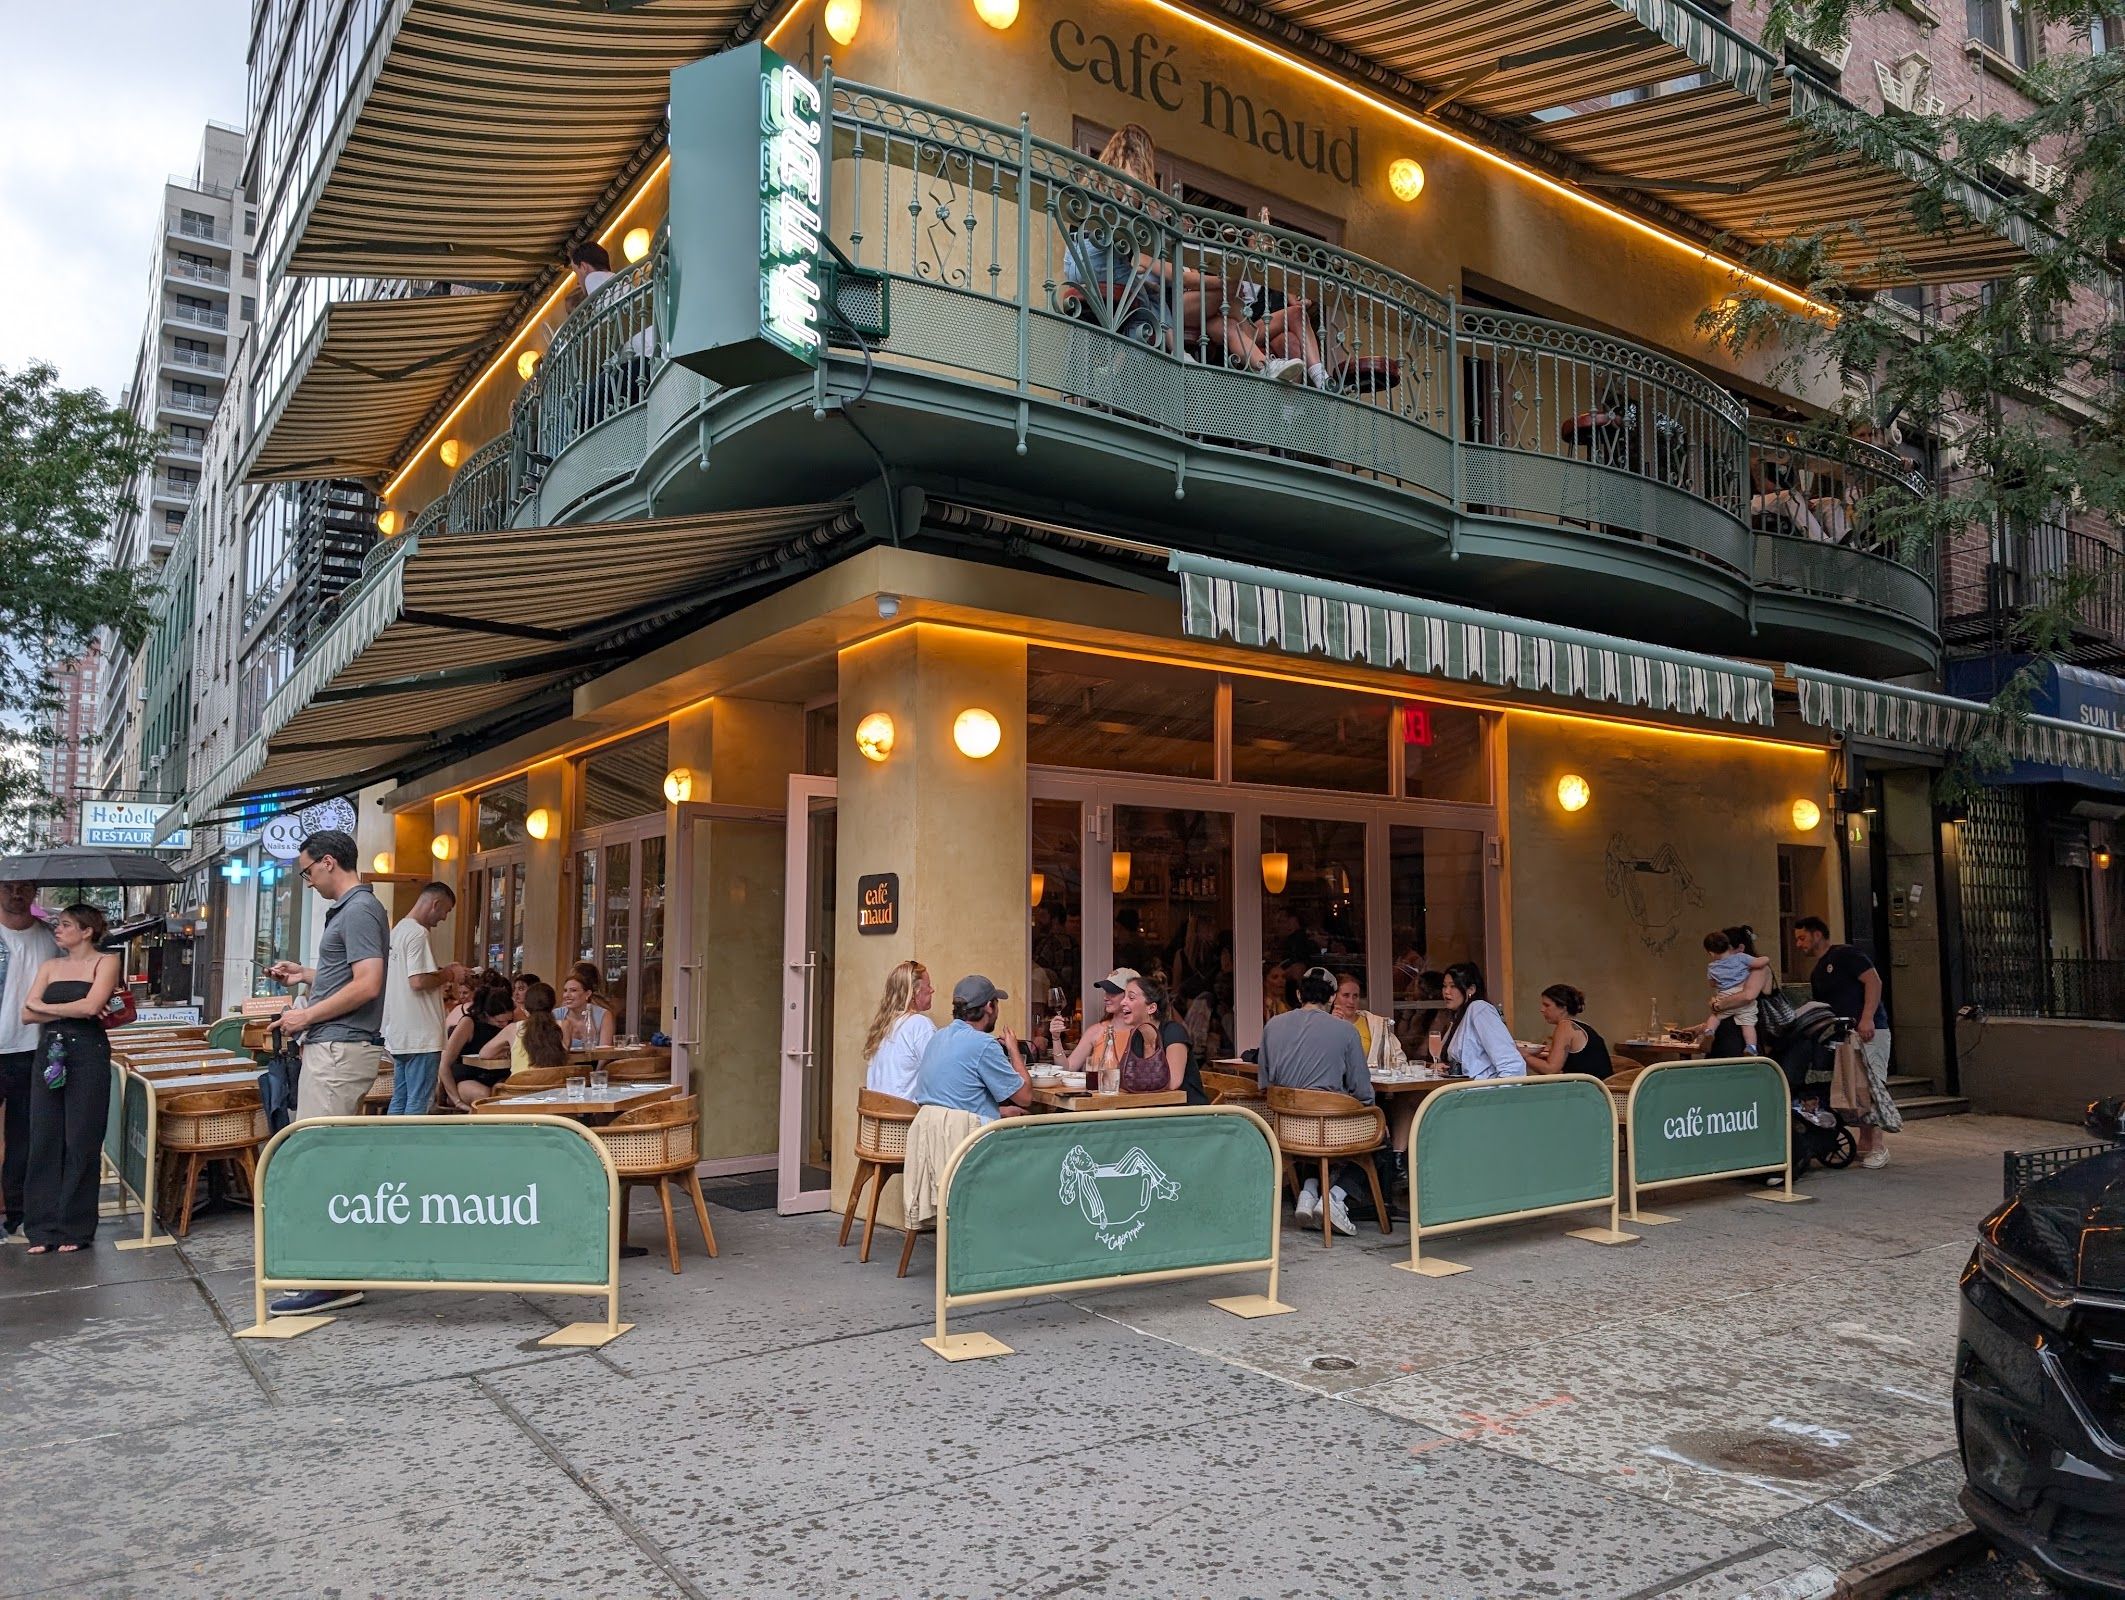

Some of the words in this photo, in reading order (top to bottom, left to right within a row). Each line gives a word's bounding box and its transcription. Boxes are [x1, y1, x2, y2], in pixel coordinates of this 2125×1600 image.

[1049, 18, 1184, 112] café
[1199, 77, 1362, 188] maud
[2080, 703, 2109, 728] SUN
[90, 805, 158, 826] Heidelb
[91, 830, 182, 844] RESTAURNT
[267, 842, 286, 850] Nails
[865, 882, 888, 905] café
[860, 903, 893, 926] maud
[1663, 1106, 1704, 1140] café
[1706, 1101, 1759, 1135] maud
[327, 1181, 411, 1225] café
[419, 1182, 541, 1226] maud
